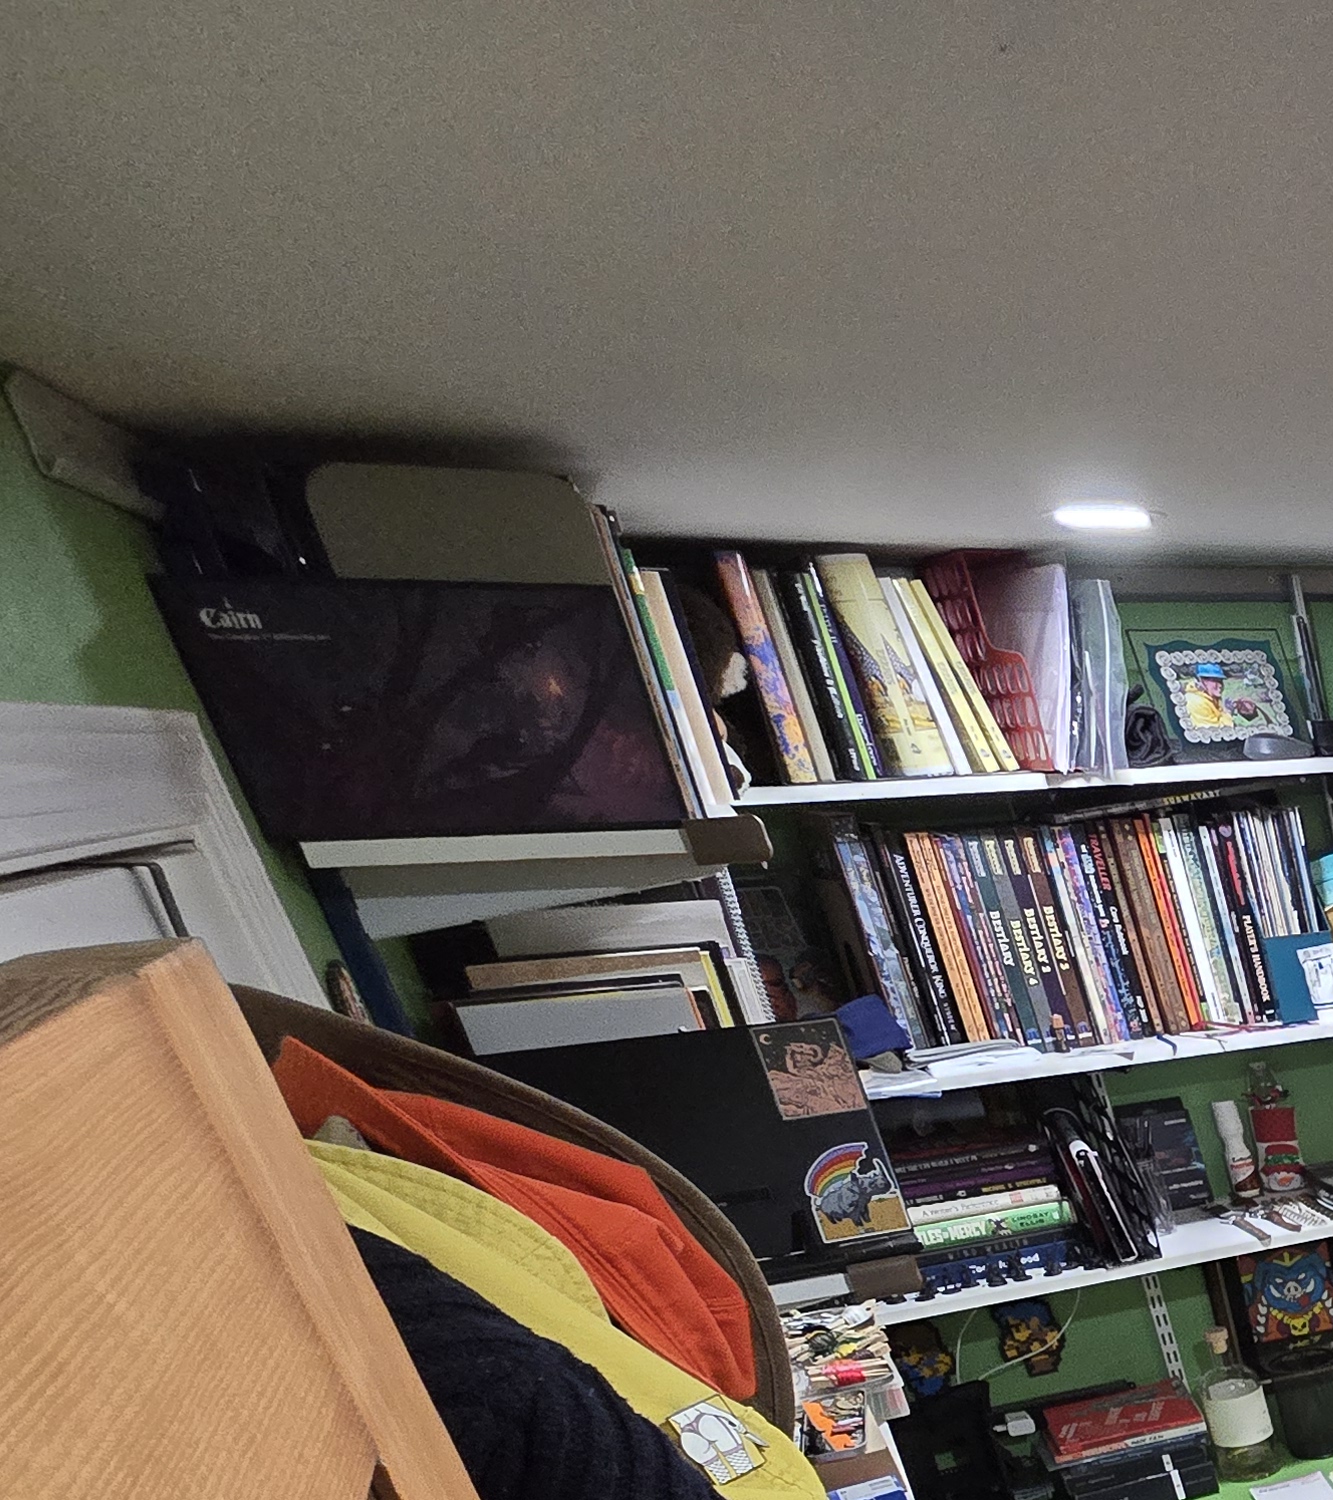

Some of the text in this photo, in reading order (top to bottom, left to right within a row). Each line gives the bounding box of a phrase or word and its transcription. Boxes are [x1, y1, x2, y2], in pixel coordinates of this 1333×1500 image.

[200, 607, 262, 629] Cairn
[1089, 834, 1112, 891] TRAVELLER
[892, 853, 921, 911] ADVENTURER
[914, 916, 940, 975] CONQUEROR
[931, 972, 947, 999] KING
[989, 910, 1015, 967] BESTIARY
[1010, 920, 1035, 981] BESTIARY
[1024, 908, 1048, 963] BESTIARY
[1043, 906, 1067, 962] BESTIARY
[1242, 914, 1271, 1002] PLAYER'S HANDBOOK
[950, 1221, 987, 1241] MERCY
[1011, 1211, 1049, 1222] LINDSAY
[1019, 1219, 1046, 1228] ELLIS
